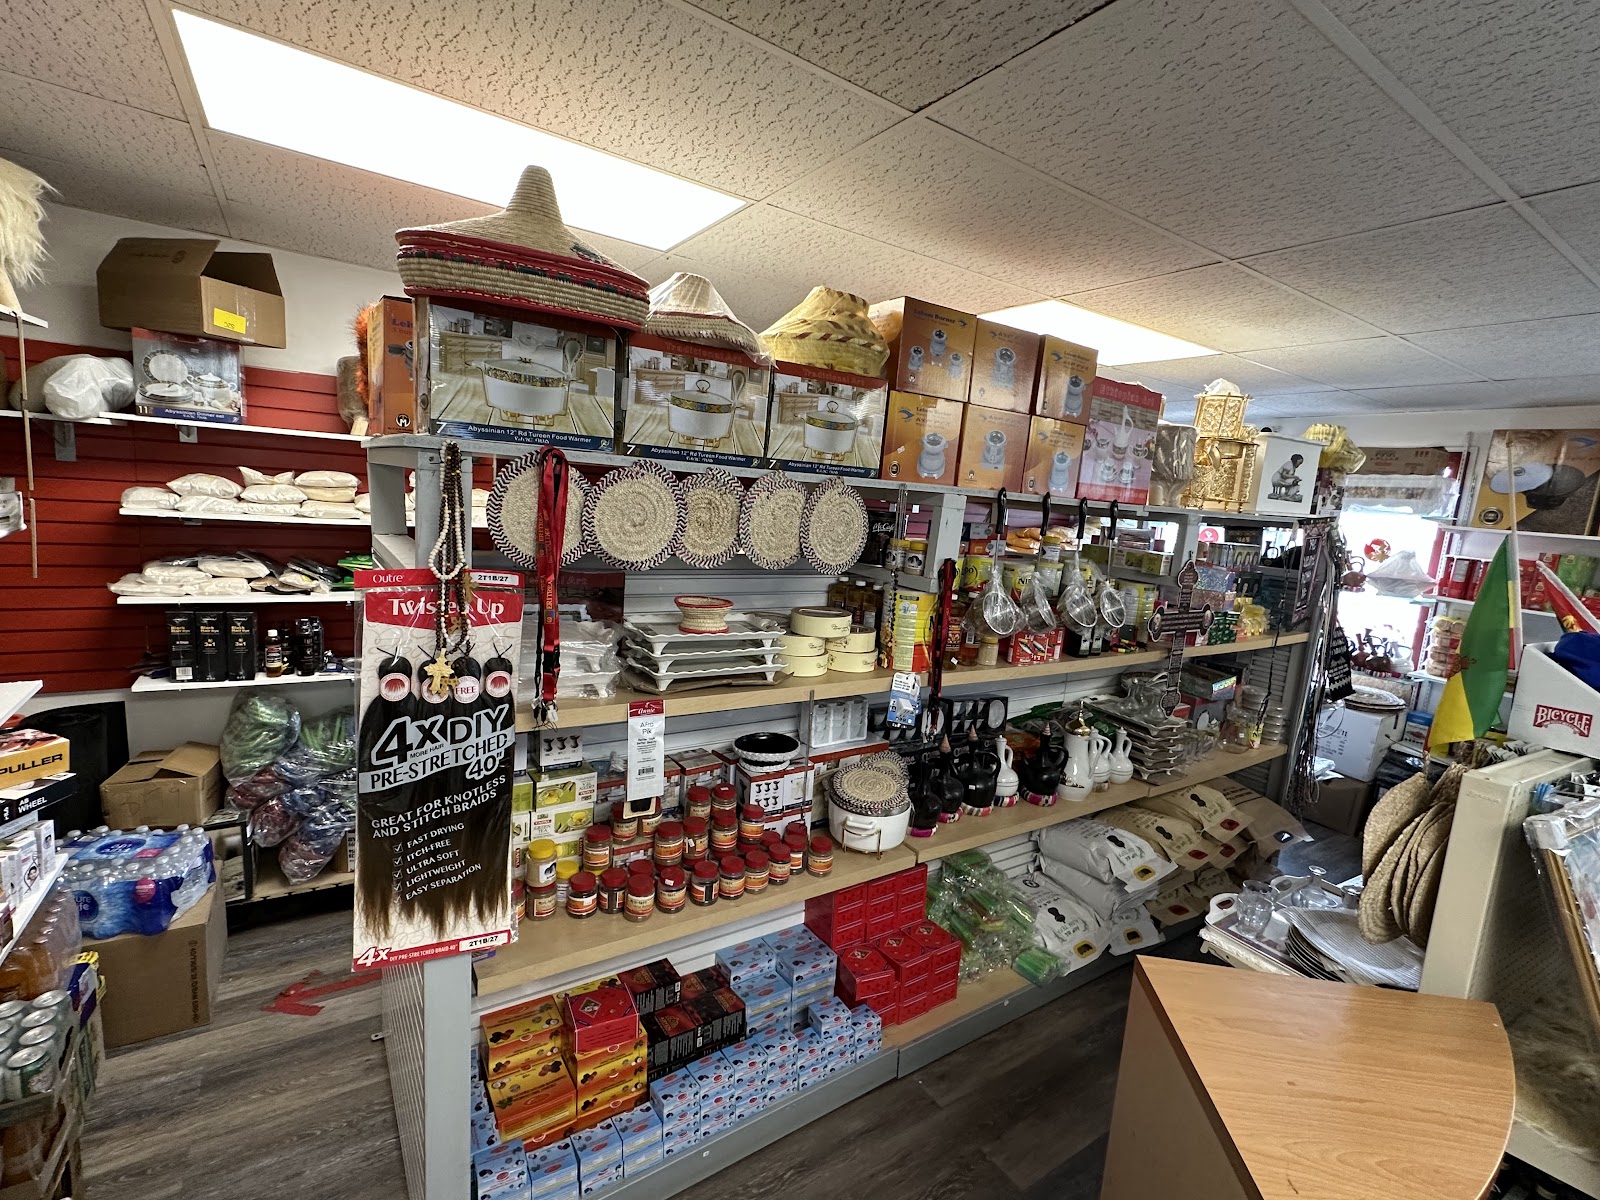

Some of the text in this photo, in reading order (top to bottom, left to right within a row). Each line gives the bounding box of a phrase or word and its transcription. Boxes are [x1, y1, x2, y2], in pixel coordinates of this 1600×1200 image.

[436, 422, 448, 434] 7
[467, 425, 505, 435] Abyssinian
[528, 431, 551, 439] Tureen
[568, 435, 592, 443] Warmer
[626, 445, 636, 455] 7
[650, 447, 680, 455] Abyssinian
[768, 460, 777, 469] 7
[373, 574, 404, 583] Outre
[477, 574, 509, 582] 2T1B/27
[476, 599, 505, 619] Up
[455, 686, 477, 694] FREE
[1535, 707, 1591, 736] BICYCLE
[410, 743, 444, 758] MORE HAIR
[371, 733, 508, 789] PRE-STRETCHED
[18, 797, 48, 814] WHEEL
[19, 797, 30, 806] AB
[371, 775, 506, 829] GREAT FOR KNOTLESS
[372, 789, 498, 839] AND STITCH BRAIDS
[406, 822, 465, 849] FAST DRYING
[406, 839, 452, 862] ITCH-FREE
[406, 850, 460, 874] ULTRA SOFT
[406, 860, 466, 887] LIGHTWEIGHT
[406, 863, 482, 900] EASY SEPARATION
[469, 936, 499, 947] 2T1B/27
